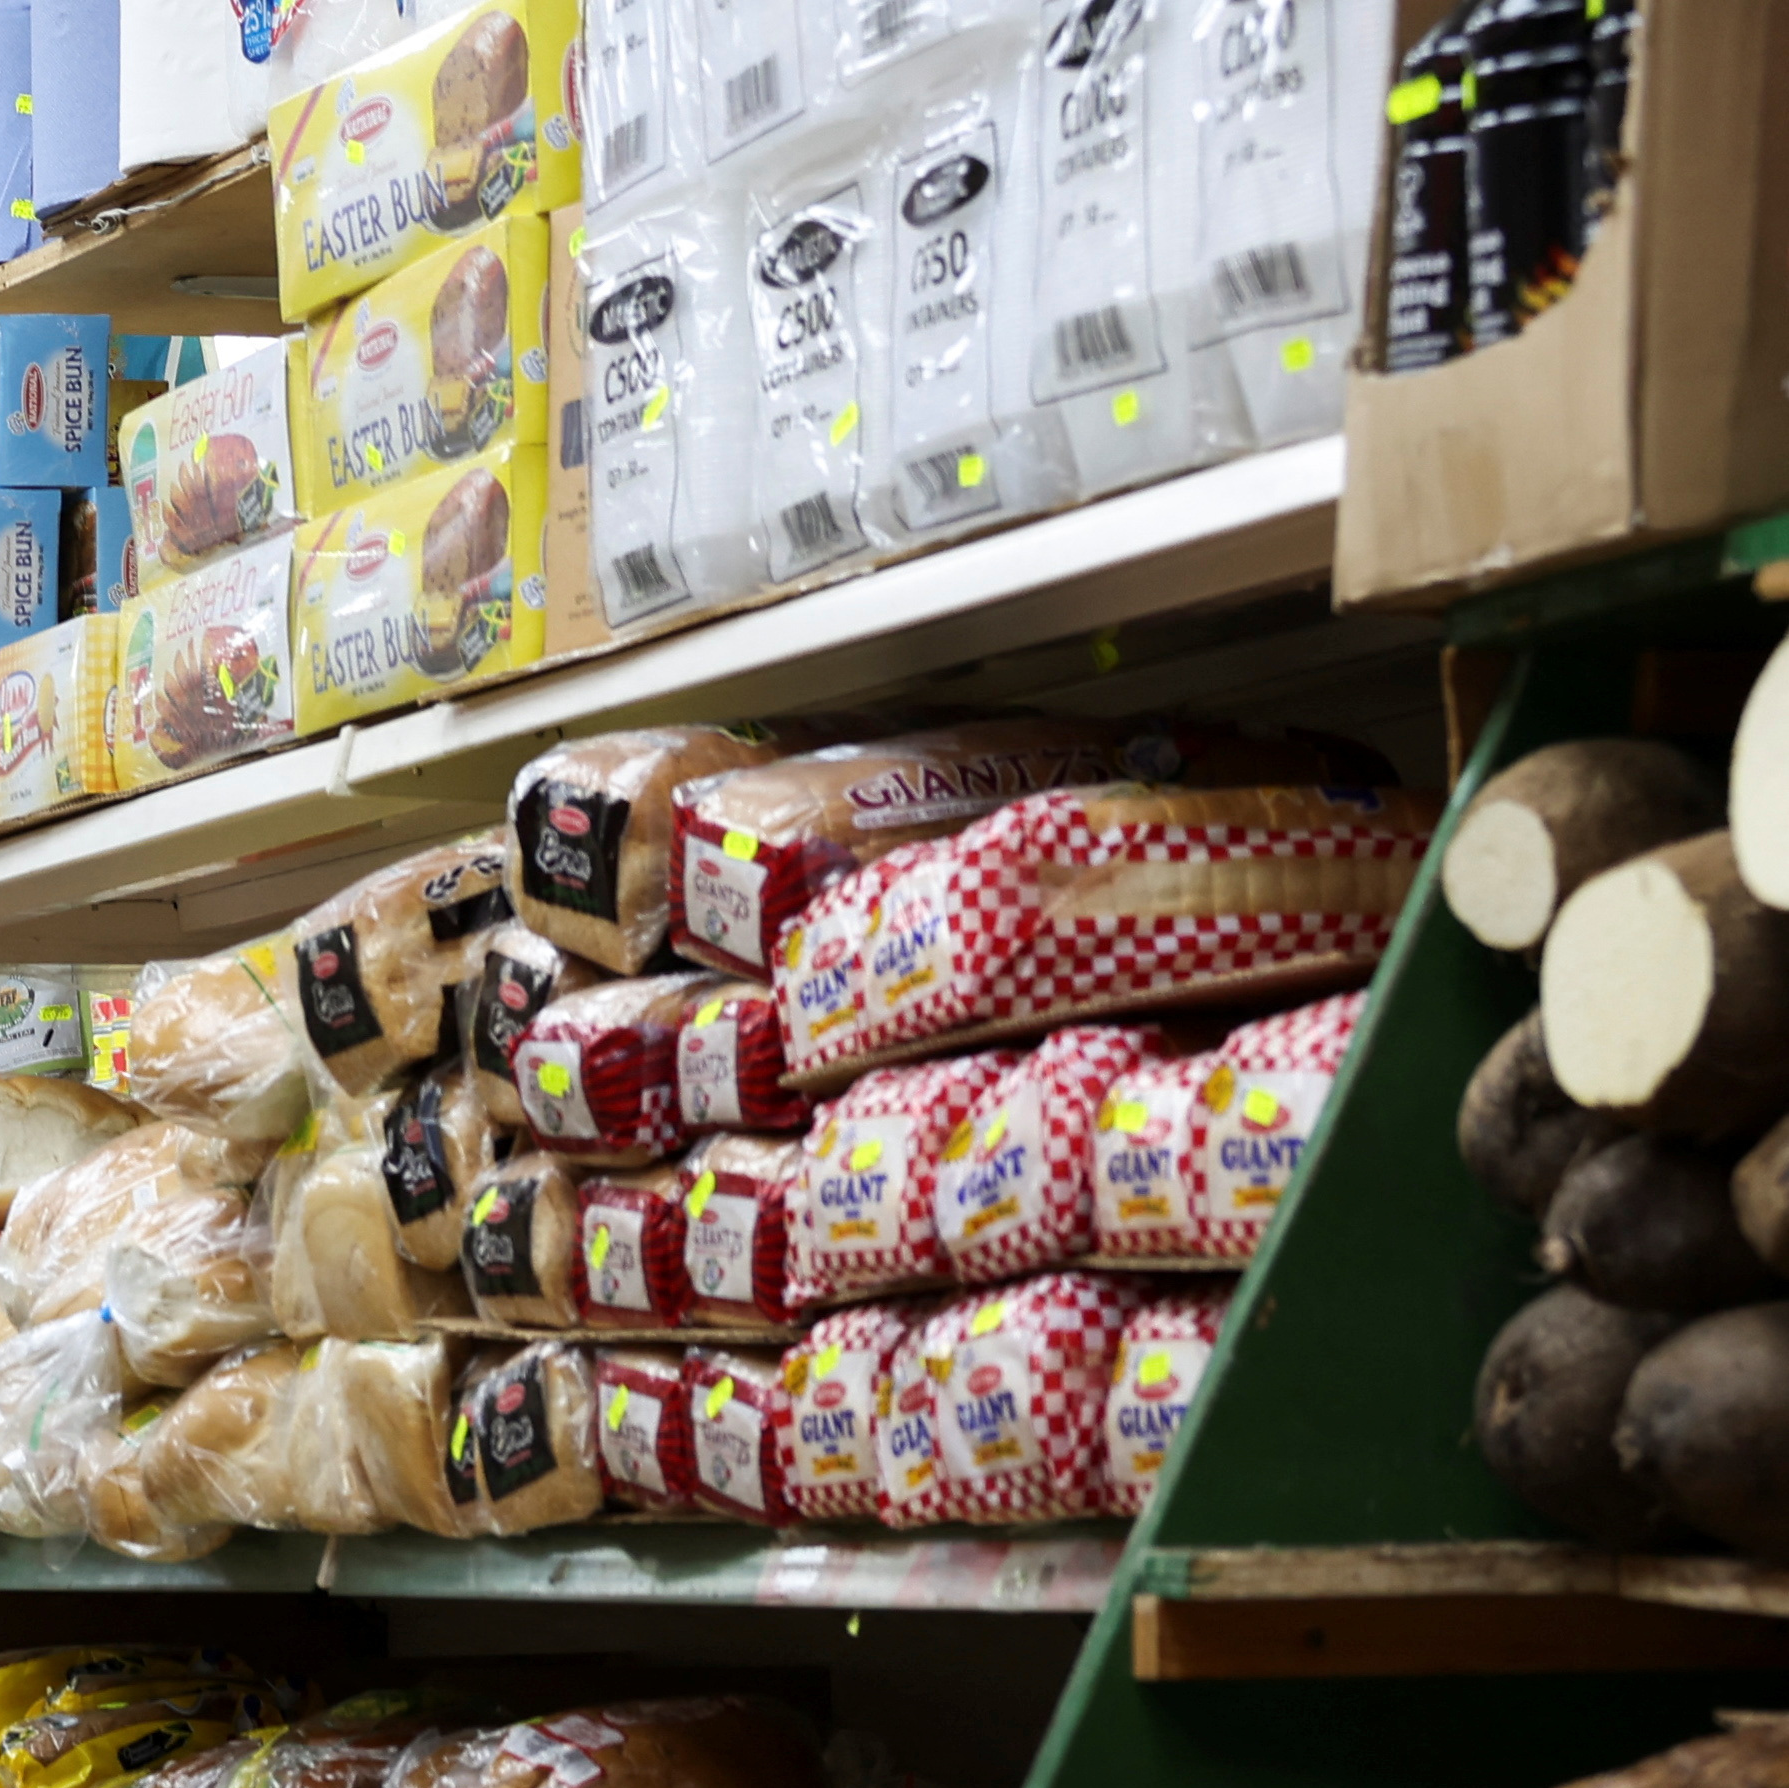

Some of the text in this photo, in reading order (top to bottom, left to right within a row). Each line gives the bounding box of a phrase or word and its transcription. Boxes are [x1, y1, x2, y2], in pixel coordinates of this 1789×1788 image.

[303, 193, 386, 273] EASTER
[64, 346, 82, 453] SPICE BUN
[168, 380, 223, 453] Easter
[310, 620, 380, 693] EASTER
[848, 755, 1025, 812] GIANT
[873, 916, 943, 976] GIANT
[821, 1174, 889, 1209] GIANT
